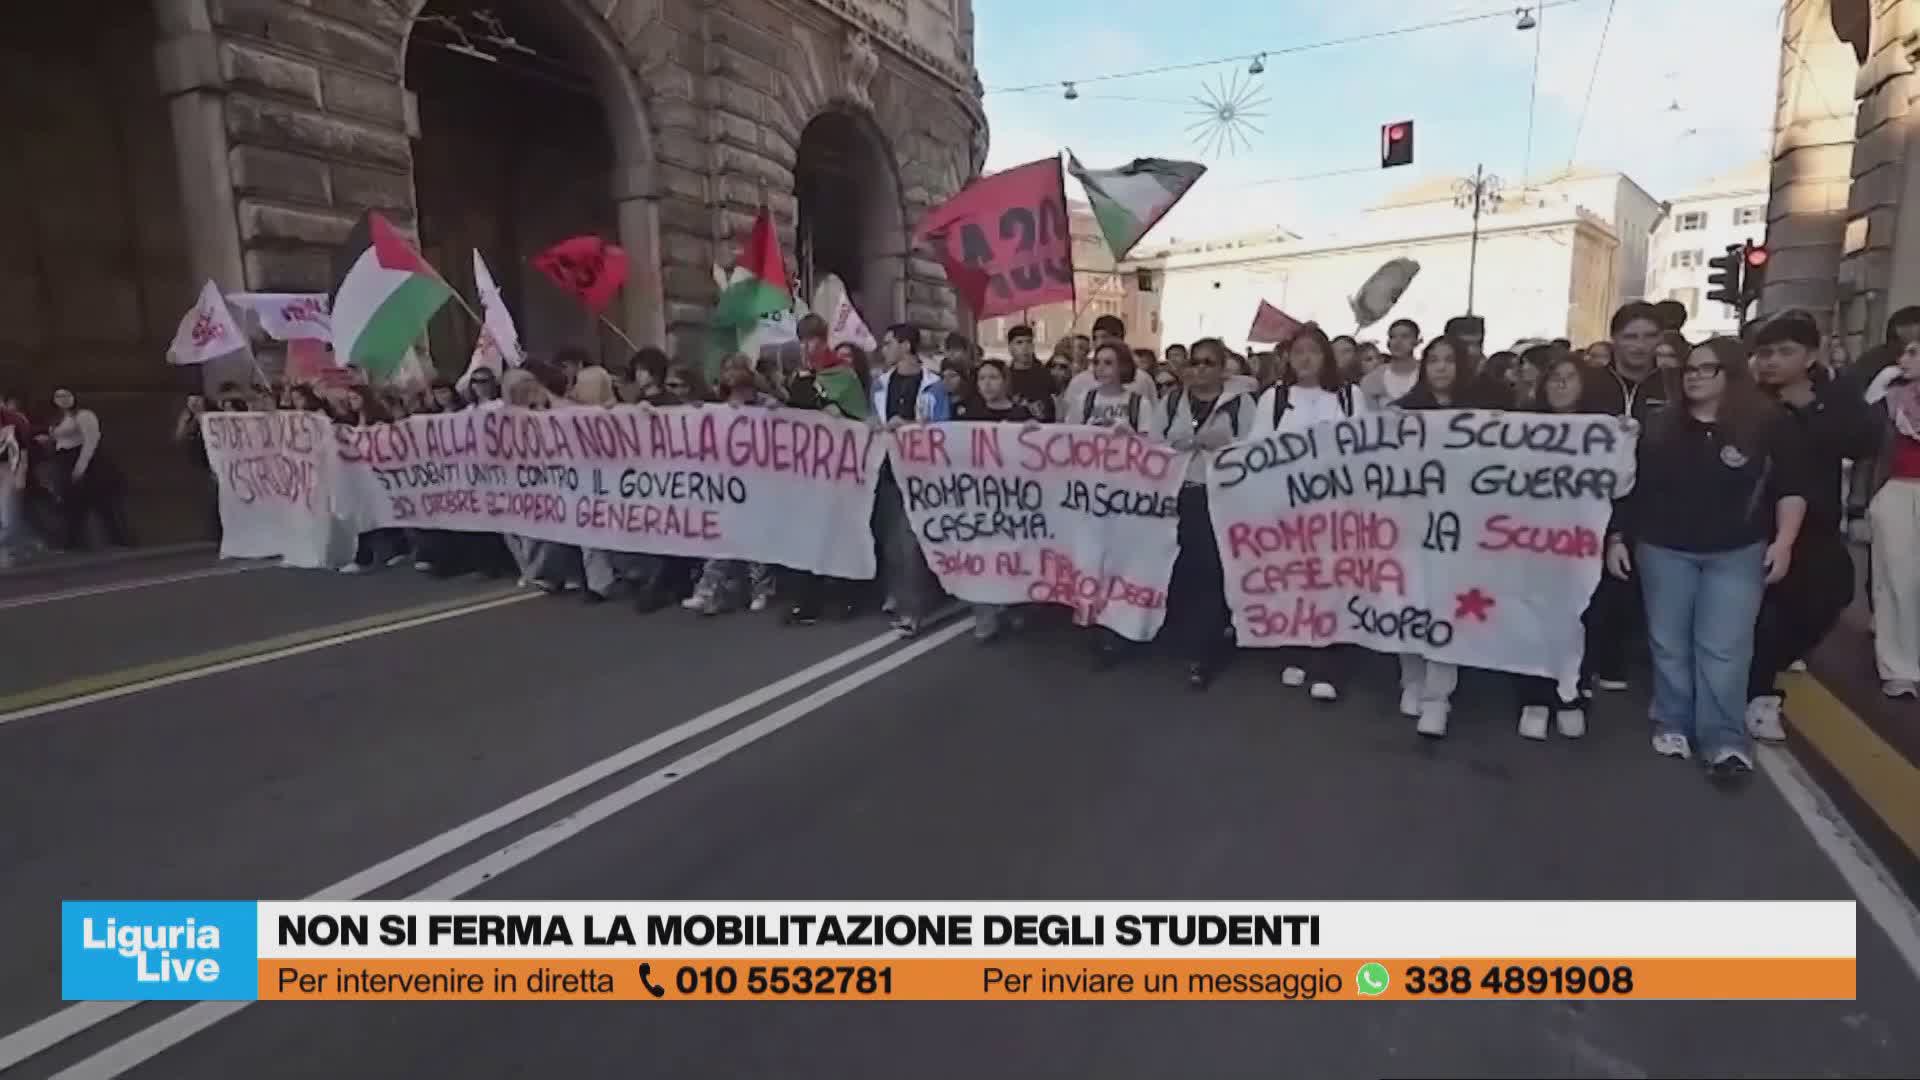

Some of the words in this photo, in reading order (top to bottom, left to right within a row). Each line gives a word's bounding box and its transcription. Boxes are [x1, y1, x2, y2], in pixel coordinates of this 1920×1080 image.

[425, 417, 477, 458] ALLA
[483, 412, 573, 460] SCUOLA
[572, 413, 641, 459] NON
[650, 412, 720, 462] ALLA
[726, 415, 877, 485] GUERRA!
[971, 427, 1003, 467] IN
[1017, 426, 1172, 481] SCIOPERO
[1214, 429, 1317, 487] SOLDI
[1334, 415, 1426, 456] ALLA
[1443, 412, 1618, 456] SCUOLA
[516, 463, 580, 490] CONTRO
[592, 468, 609, 496] IL
[618, 466, 747, 505] GOVERNO
[906, 473, 1043, 512] ROMPIAMO
[1285, 465, 1353, 508] NON
[1364, 459, 1446, 500] ALLA
[1470, 464, 1618, 500] GUERRA
[575, 495, 722, 540] GENERALE
[1226, 510, 1399, 558] ROMPIAMO
[1422, 511, 1461, 553] LA
[995, 552, 1032, 576] AL
[1240, 556, 1405, 596] CASERMA
